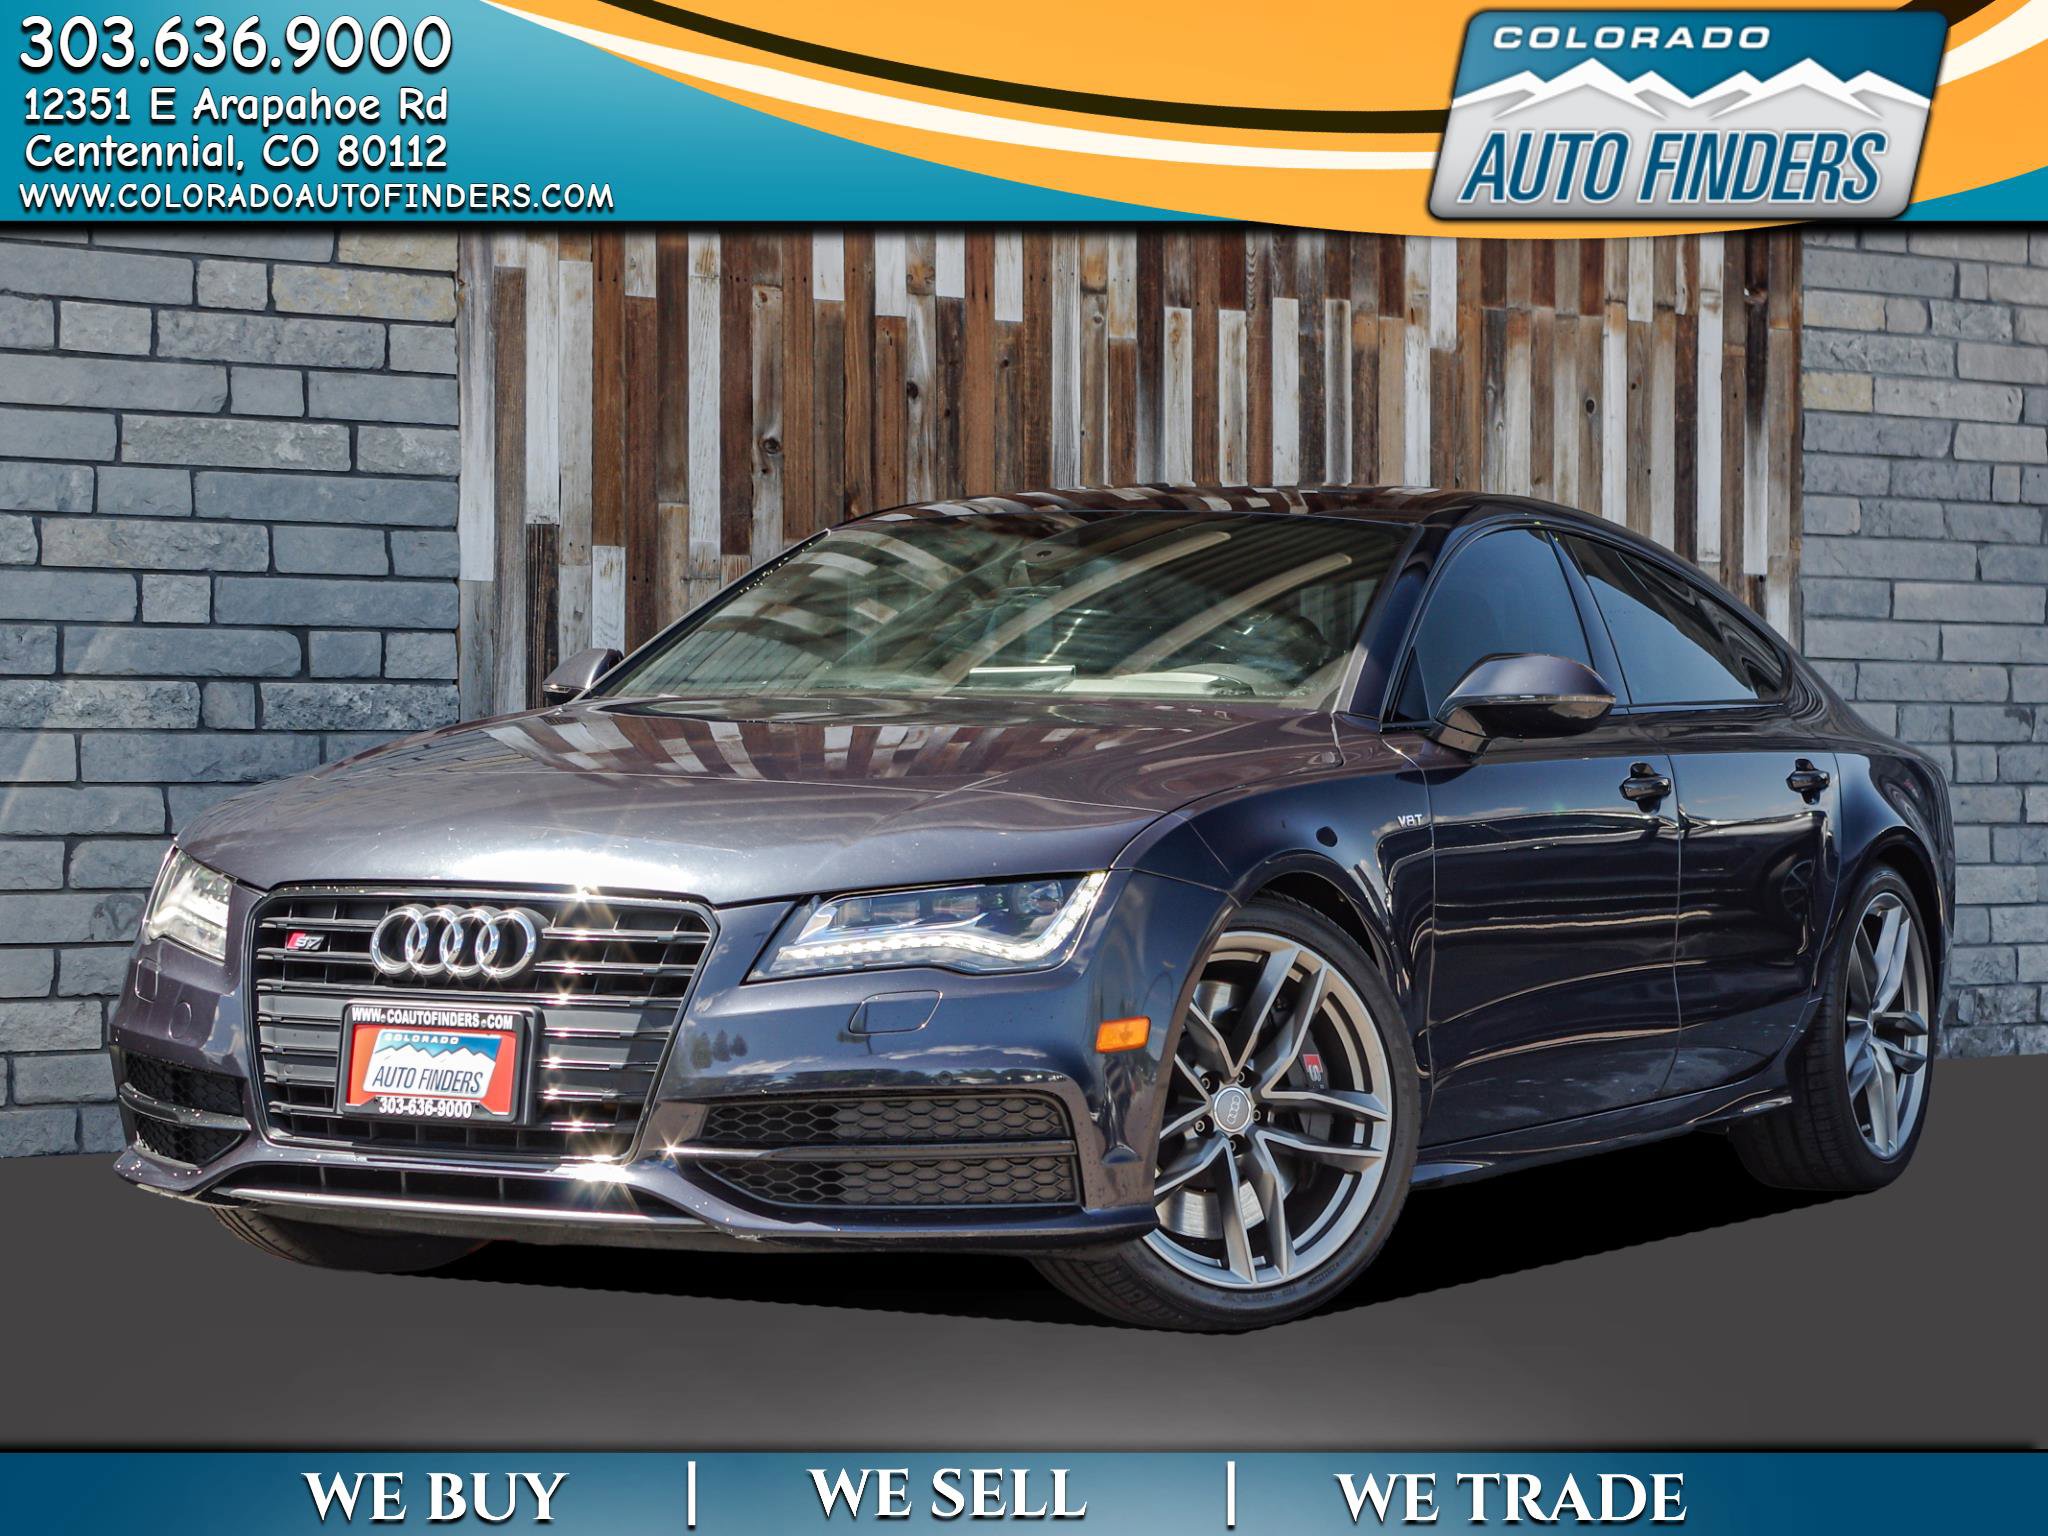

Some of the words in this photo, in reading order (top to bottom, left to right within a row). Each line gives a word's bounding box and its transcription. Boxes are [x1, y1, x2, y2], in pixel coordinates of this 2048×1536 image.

[1398, 813, 1423, 828] V8T
[384, 1033, 459, 1045] COLORADO
[372, 1066, 417, 1089] AUTO
[418, 1068, 484, 1094] FINDERS
[379, 1096, 472, 1119] 303-636-9000
